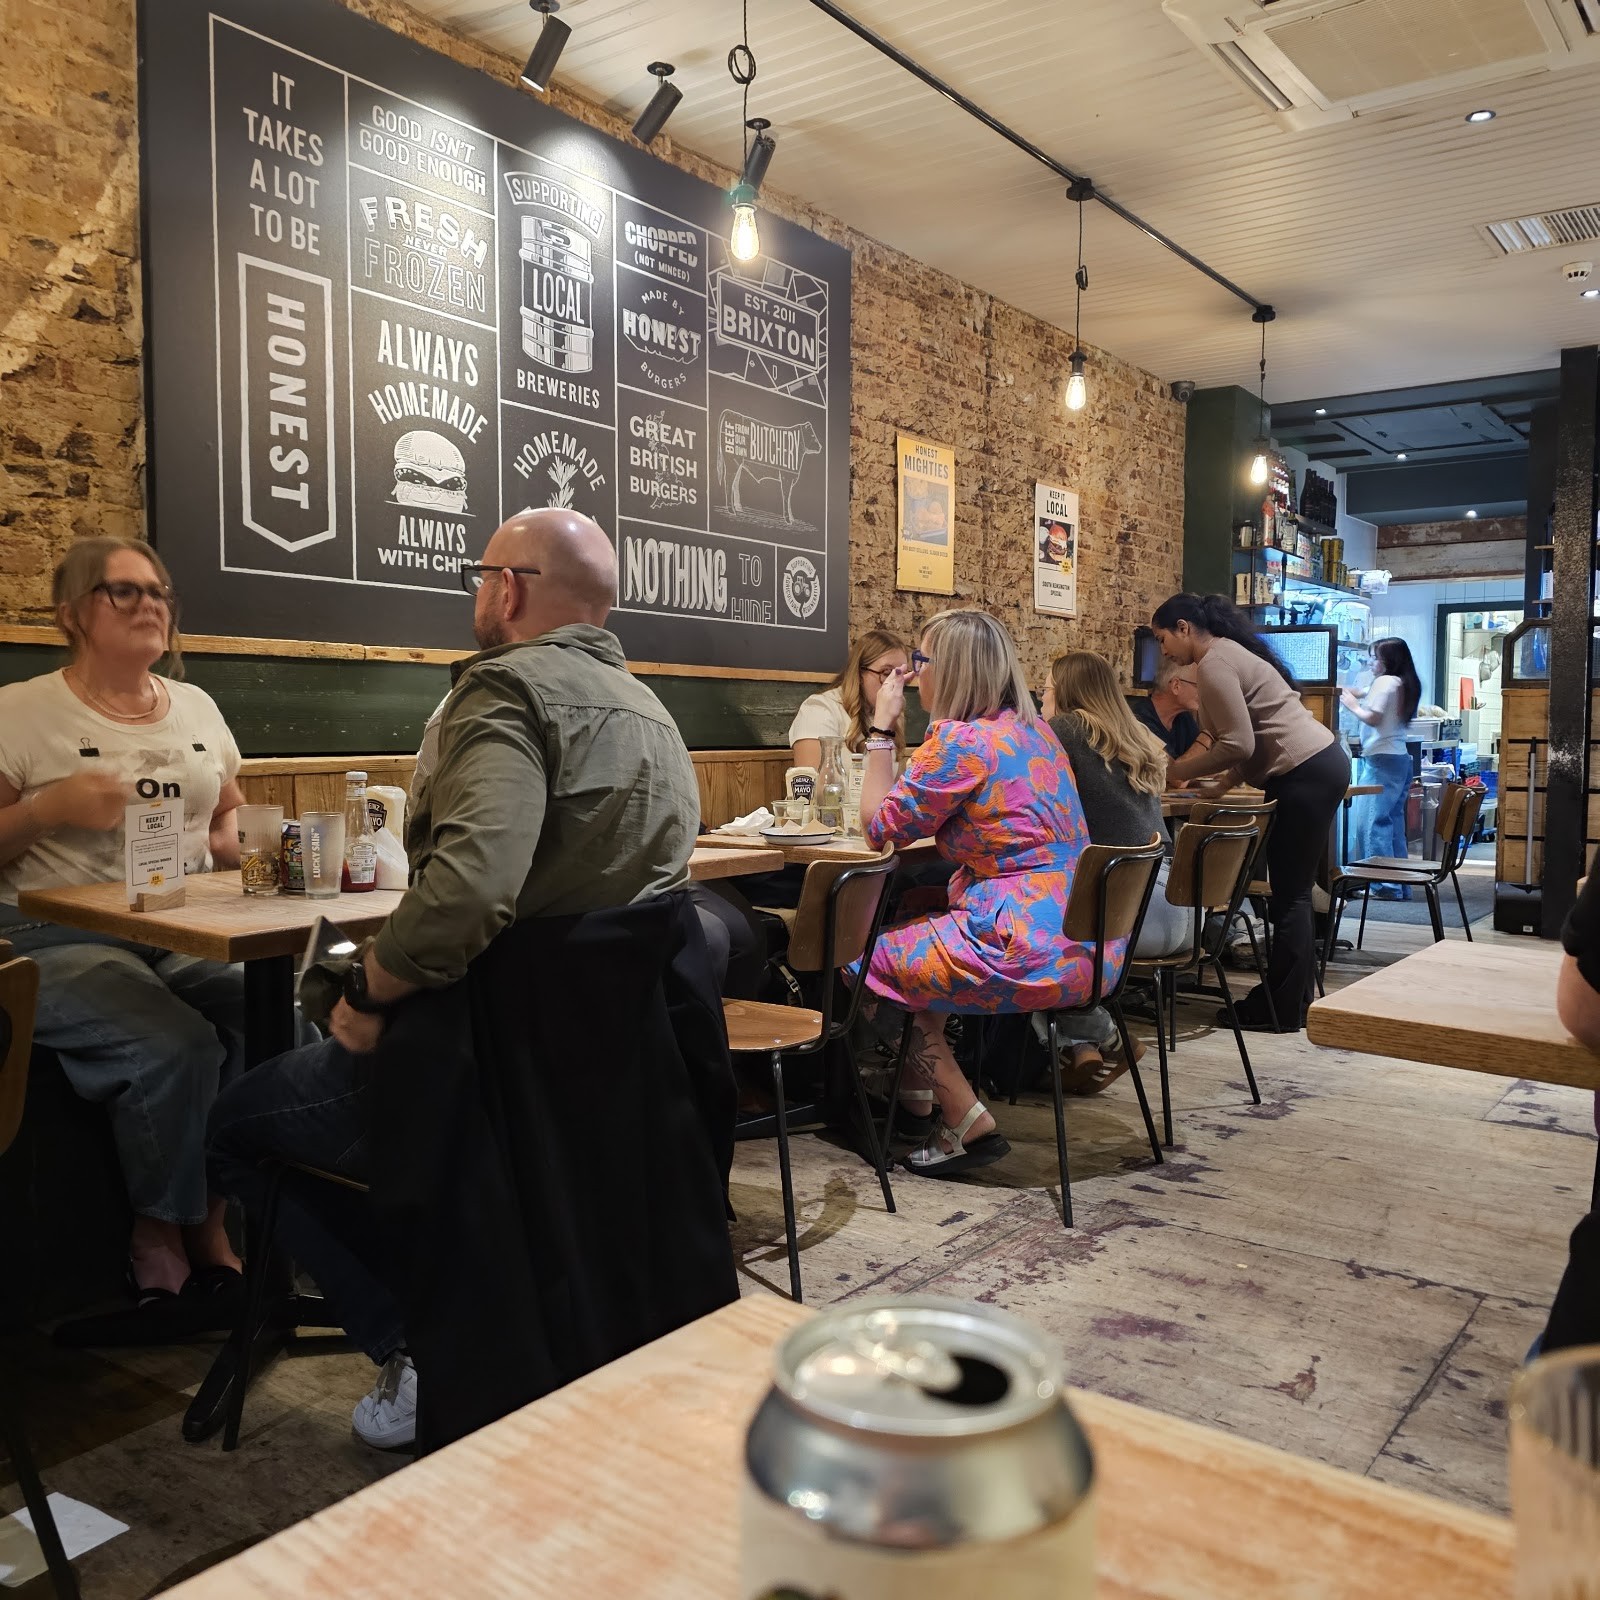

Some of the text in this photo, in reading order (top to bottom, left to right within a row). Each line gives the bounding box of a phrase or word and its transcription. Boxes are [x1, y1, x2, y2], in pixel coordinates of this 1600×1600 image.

[272, 71, 295, 110] IT
[243, 107, 324, 166] TAKES
[372, 105, 475, 164] GOOD ISN'T
[359, 128, 486, 196] GOOD ENOUGH
[250, 158, 320, 209] A LOT
[512, 178, 600, 235] SUPPORTING
[250, 203, 320, 256] TO BE
[359, 197, 487, 269] FRESH
[405, 235, 448, 257] NEVER
[625, 221, 698, 268] CHOPPED
[365, 237, 485, 312] FROZEN
[634, 250, 690, 282] (NOT MINCED)
[533, 268, 585, 325] LOCAL
[641, 290, 685, 316] MADE BY
[744, 292, 796, 325] EST. 2011
[622, 308, 701, 356] HONEST
[723, 304, 815, 362] BRIXTON
[377, 320, 479, 387] ALWAYS
[517, 368, 600, 409] BREWERIES
[640, 361, 687, 389] BURGERS
[267, 292, 310, 509] HONEST
[368, 381, 488, 444] HOMEMADE
[629, 416, 697, 450] GREAT
[725, 420, 735, 454] BEEF
[735, 423, 749, 435] FROM
[735, 434, 746, 446] OUR
[750, 421, 800, 471] BUTCHERY
[513, 431, 606, 492] HOMEMADE
[630, 446, 698, 479] BRITISH
[735, 445, 747, 457] OWN
[904, 454, 949, 480] MIGHTIES
[915, 445, 938, 460] HONEST
[630, 475, 697, 505] BURGERS
[1049, 490, 1066, 501] KEEP IT
[1046, 500, 1068, 517] LOCAL
[398, 515, 466, 554] ALWAYS
[377, 547, 428, 570] WITH
[624, 536, 728, 614] NOTHING
[738, 553, 762, 587] TO
[731, 597, 772, 624] HIDE
[135, 778, 181, 799] On
[147, 822, 164, 830] LOCAL
[312, 852, 321, 878] LUCKY
